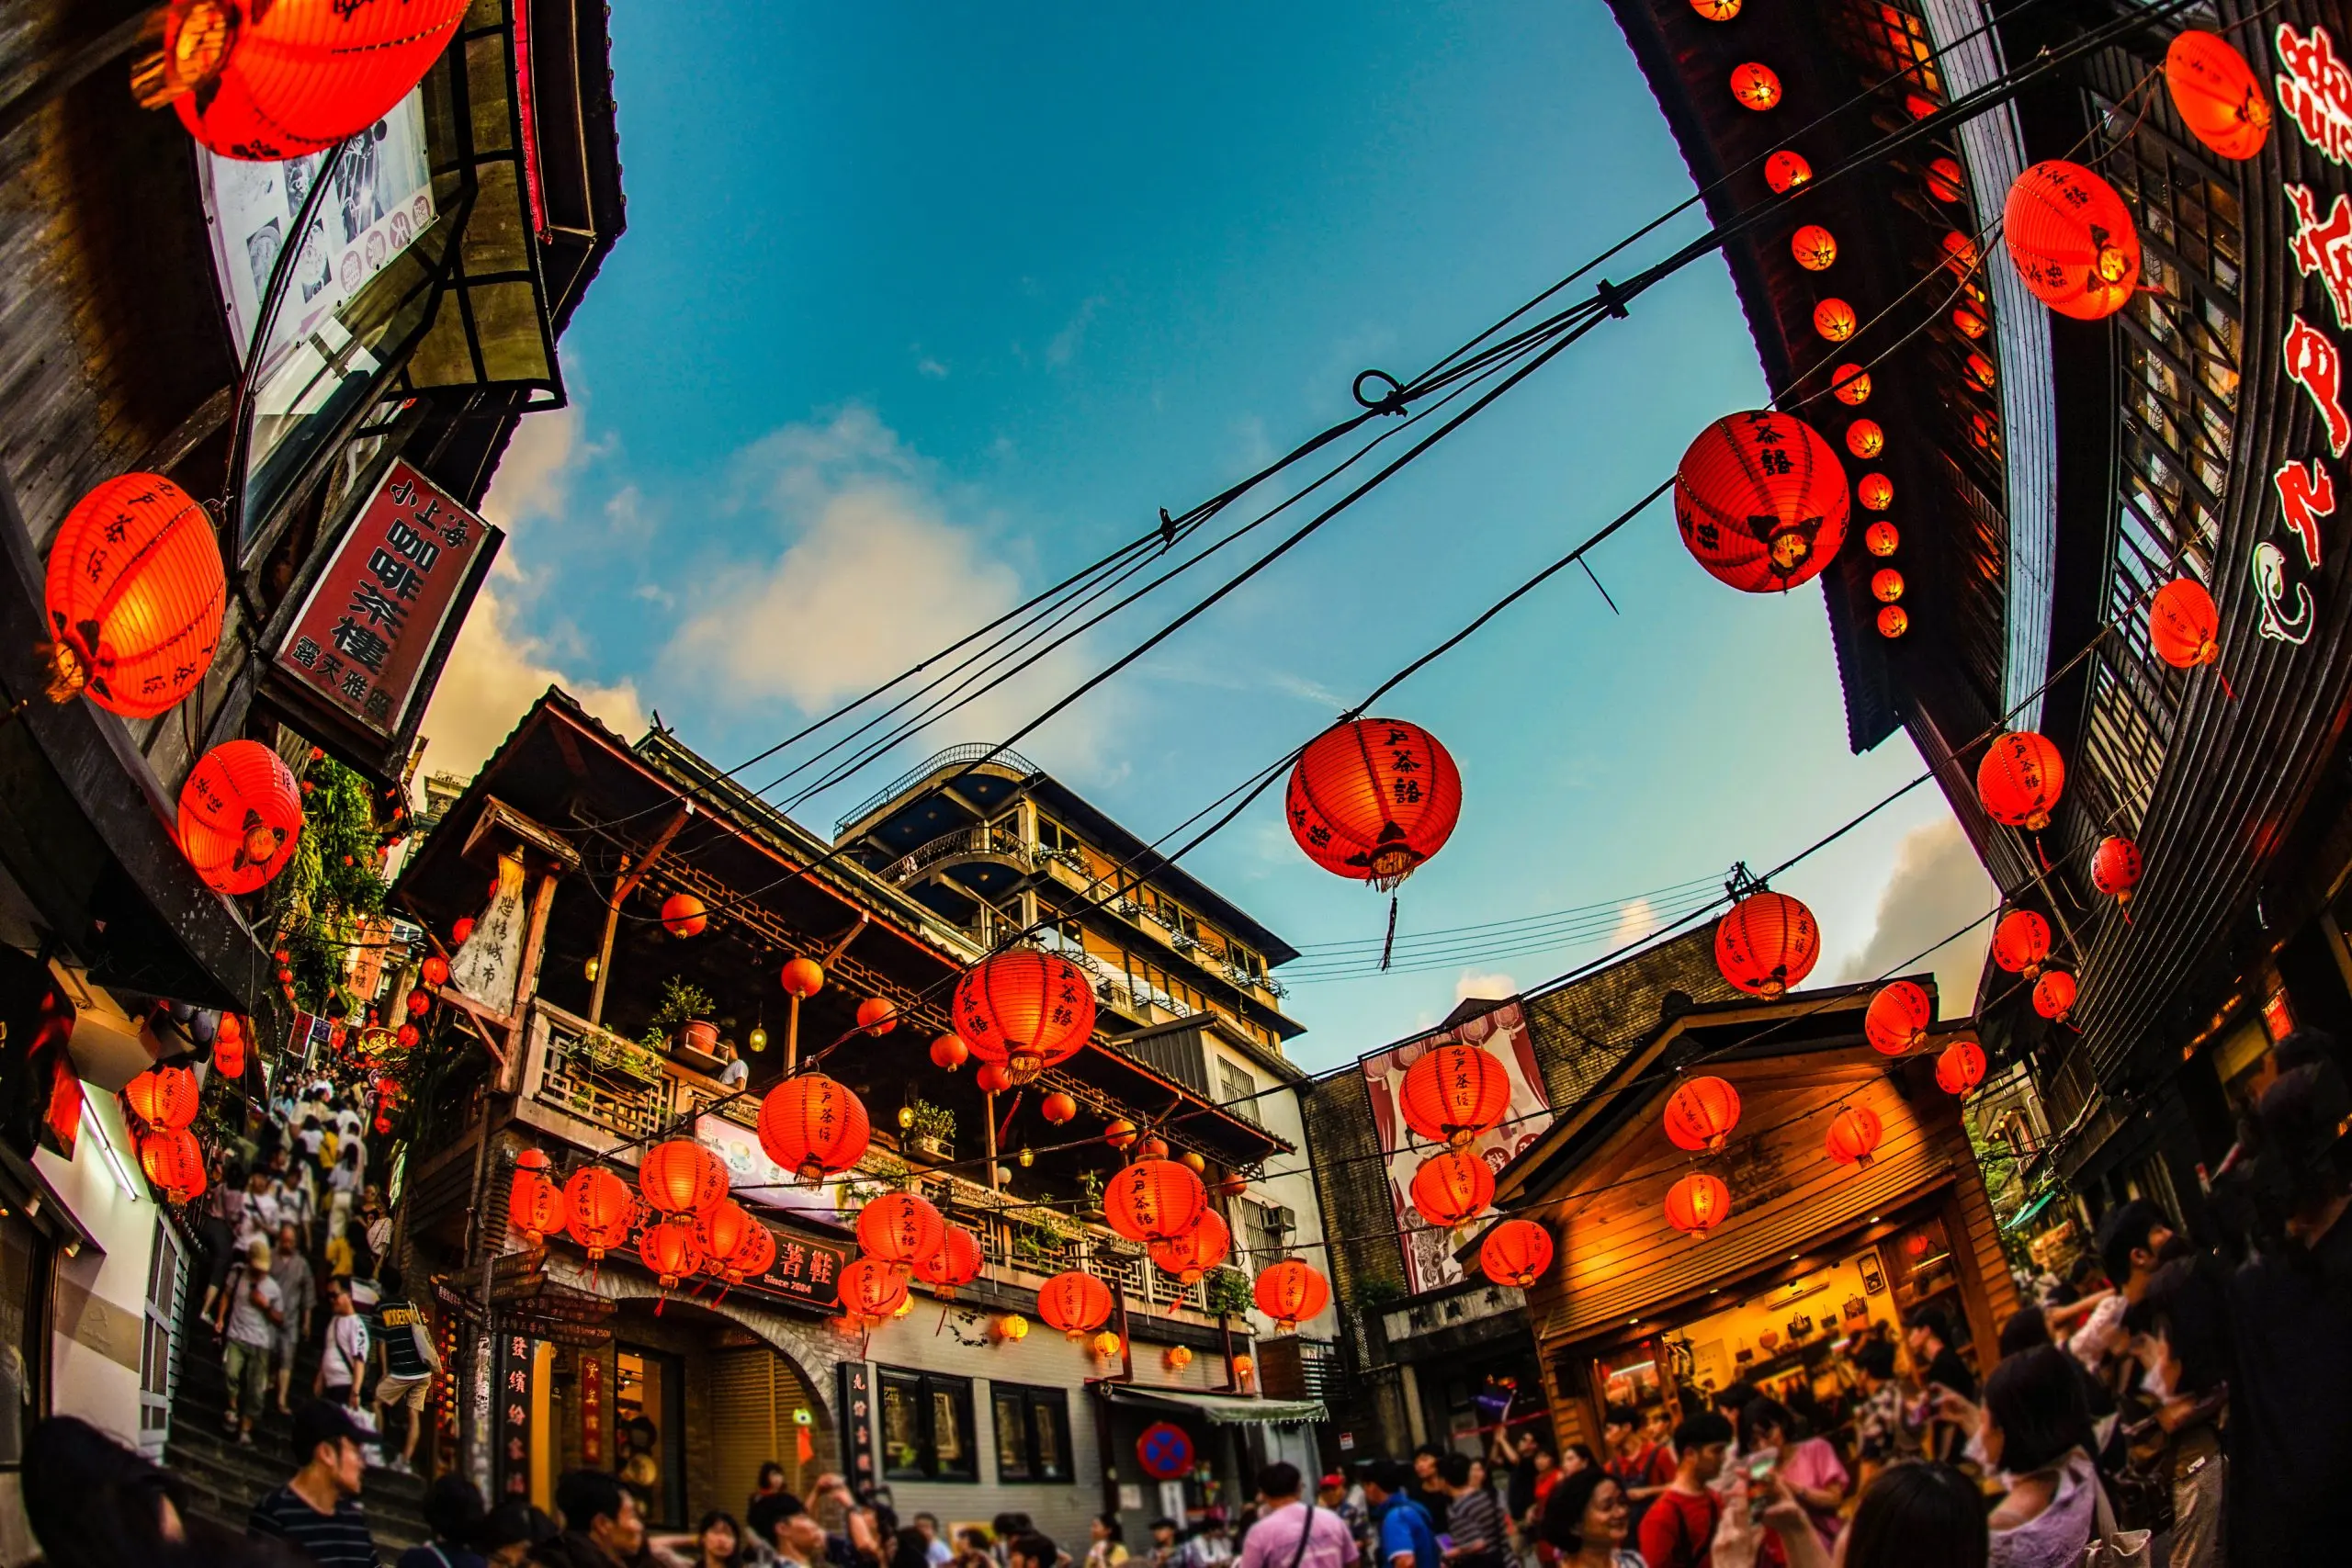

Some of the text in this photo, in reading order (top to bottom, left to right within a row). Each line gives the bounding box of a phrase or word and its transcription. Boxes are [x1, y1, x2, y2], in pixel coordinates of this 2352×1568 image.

[390, 479, 470, 549] 小上海
[763, 1274, 789, 1289] Since
